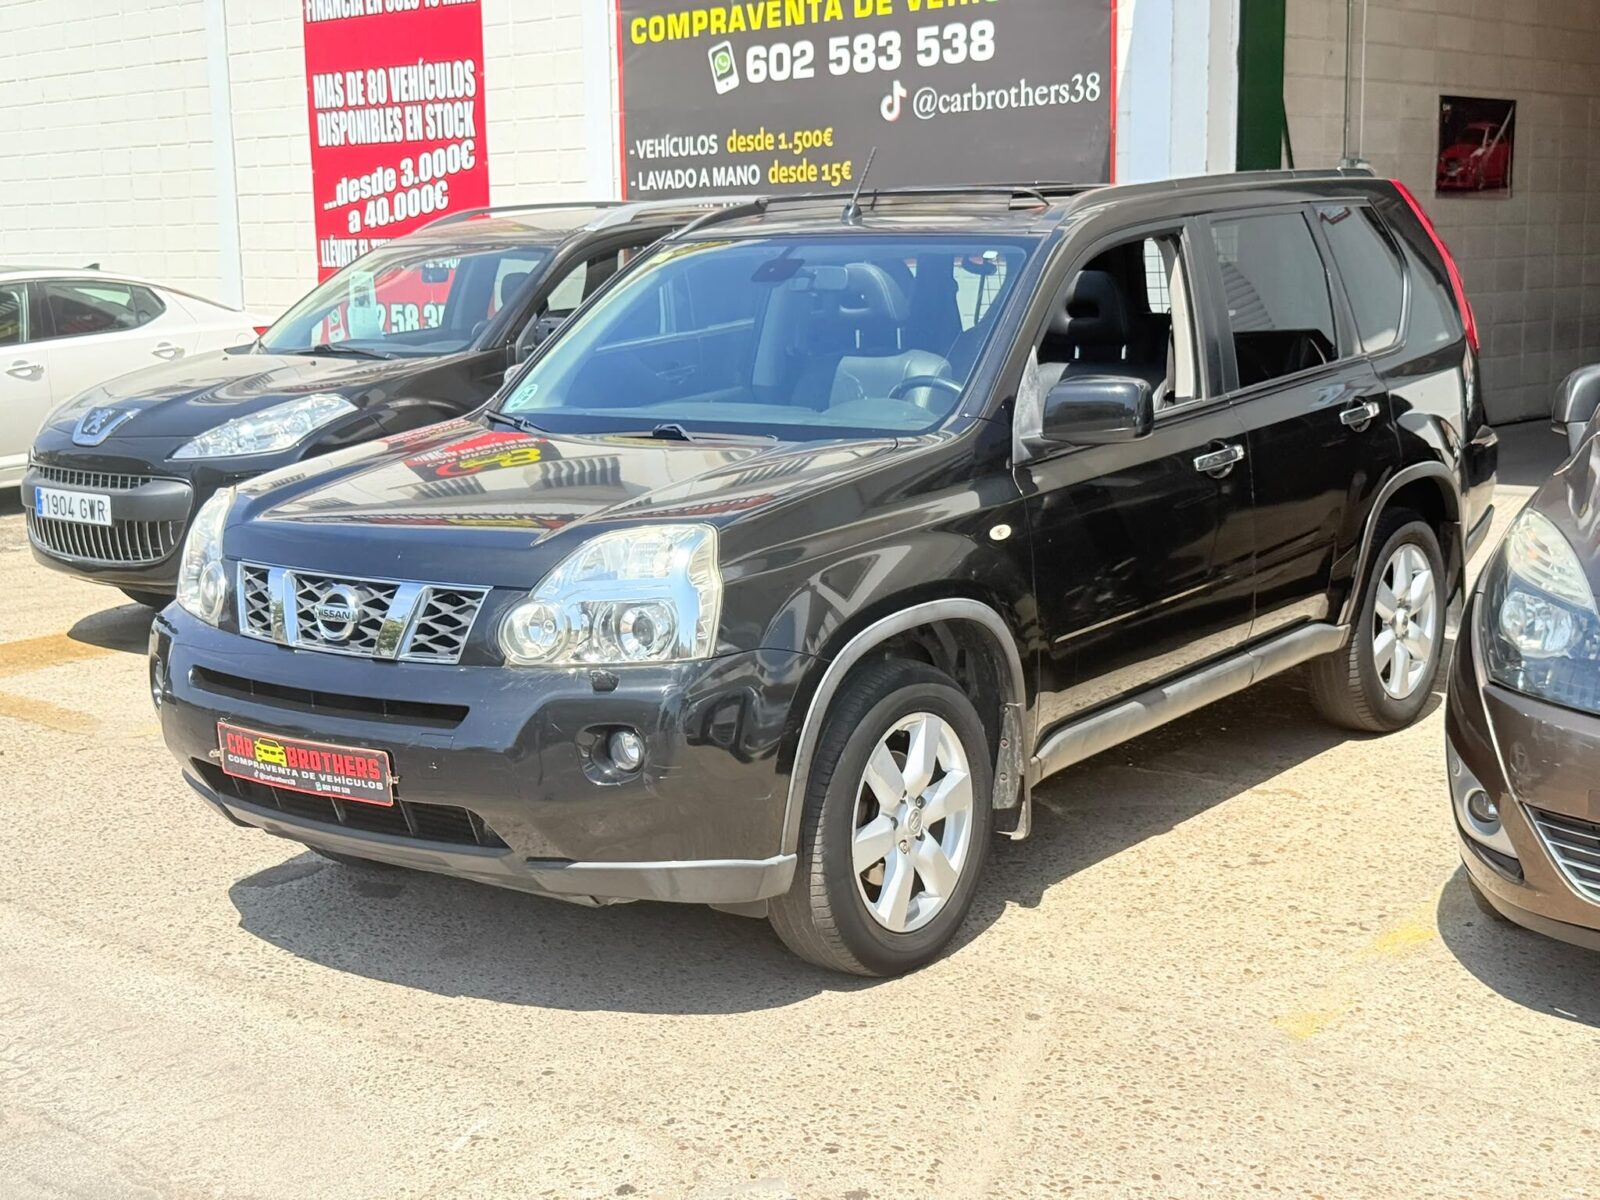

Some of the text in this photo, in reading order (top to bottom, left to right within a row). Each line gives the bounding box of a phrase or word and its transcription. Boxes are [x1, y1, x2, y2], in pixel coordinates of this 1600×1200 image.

[630, 0, 893, 44] COMPRAVENTA DE
[746, 19, 995, 83] 602 583 538
[313, 58, 476, 109] MAS DE 80 VEHÍCULOS
[912, 72, 1101, 120] @carbrothers38
[317, 101, 476, 146] DISPONIBLES EN STOCK
[727, 127, 775, 153] desde
[778, 128, 834, 154] 1.500€
[400, 140, 475, 187] 3.000€
[698, 168, 711, 188] A
[713, 164, 761, 187] MANO
[768, 158, 818, 184] desde
[821, 160, 852, 187] 15€
[348, 180, 449, 233] a 40.000€
[45, 494, 106, 522] 1904 GWR
[317, 607, 351, 619] ISSAN
[226, 733, 255, 758] CAR
[285, 746, 381, 779] BROTHERS
[227, 754, 299, 777] COMPRAVENTA
[302, 770, 316, 780] DE
